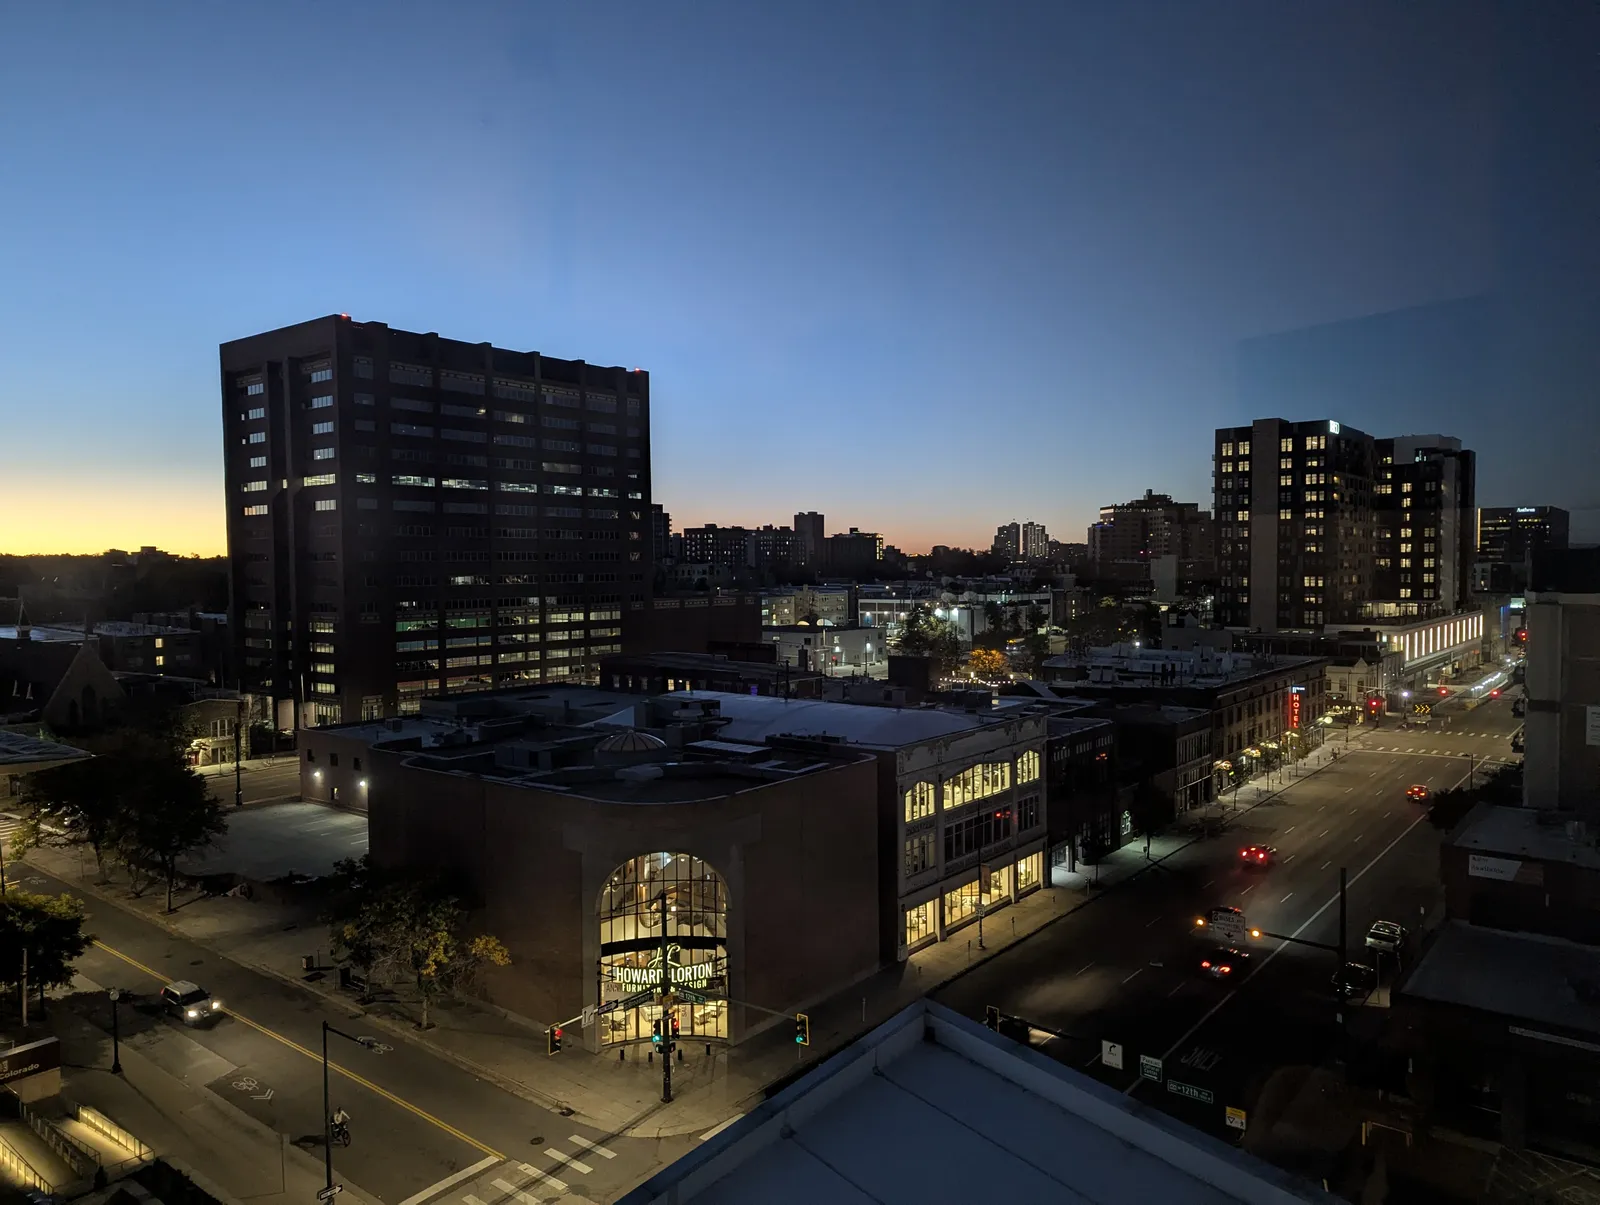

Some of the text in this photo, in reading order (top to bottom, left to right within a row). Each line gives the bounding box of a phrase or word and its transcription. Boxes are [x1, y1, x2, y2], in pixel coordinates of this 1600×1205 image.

[616, 962, 713, 984] HOWARD LORTON
[1181, 1085, 1199, 1098] 12th
